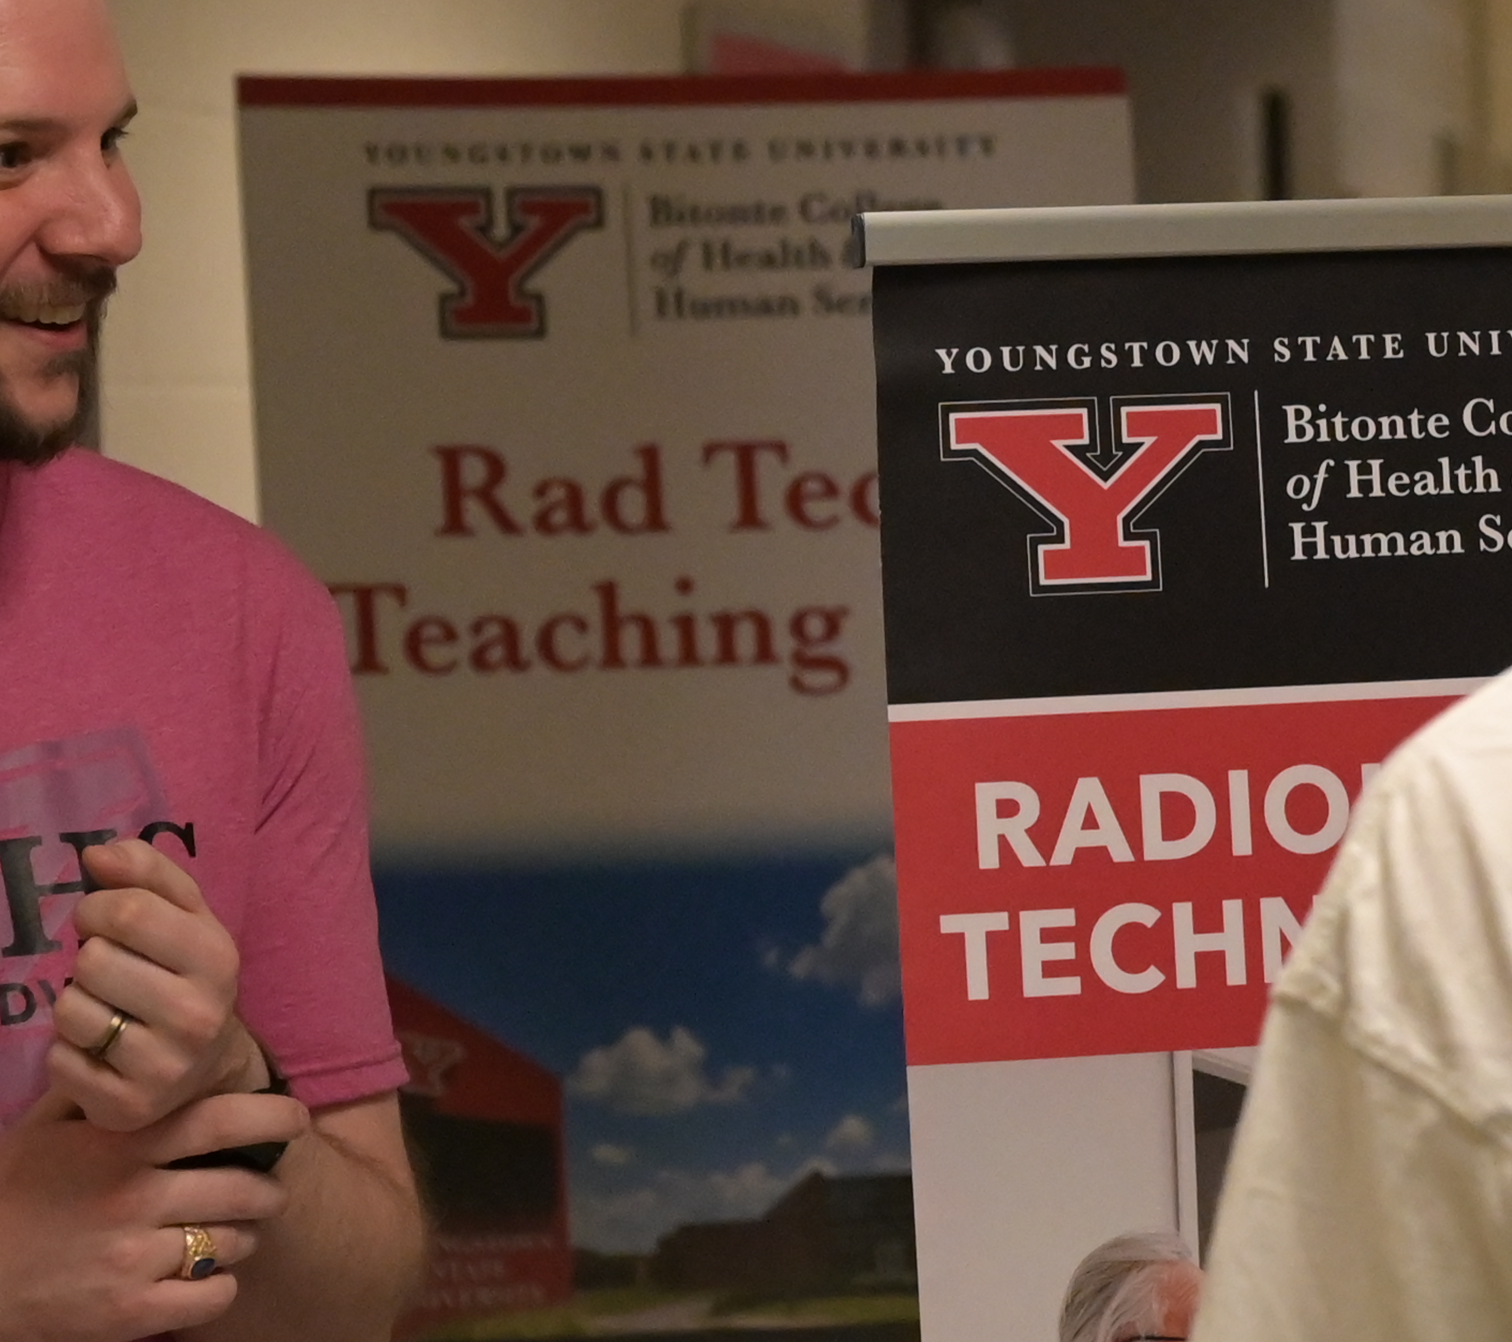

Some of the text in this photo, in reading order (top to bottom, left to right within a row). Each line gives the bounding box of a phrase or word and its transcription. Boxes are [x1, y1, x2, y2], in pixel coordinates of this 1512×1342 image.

[935, 338, 1252, 375] YOUNGSTOWN
[1273, 333, 1405, 363] STATE
[1283, 402, 1451, 444] Bitonte
[432, 443, 671, 537] Rad
[1287, 460, 1330, 510] of
[1345, 454, 1503, 498] Health
[1289, 519, 1465, 562] Human
[326, 577, 852, 696] Teaching
[975, 763, 1381, 870] RADIO
